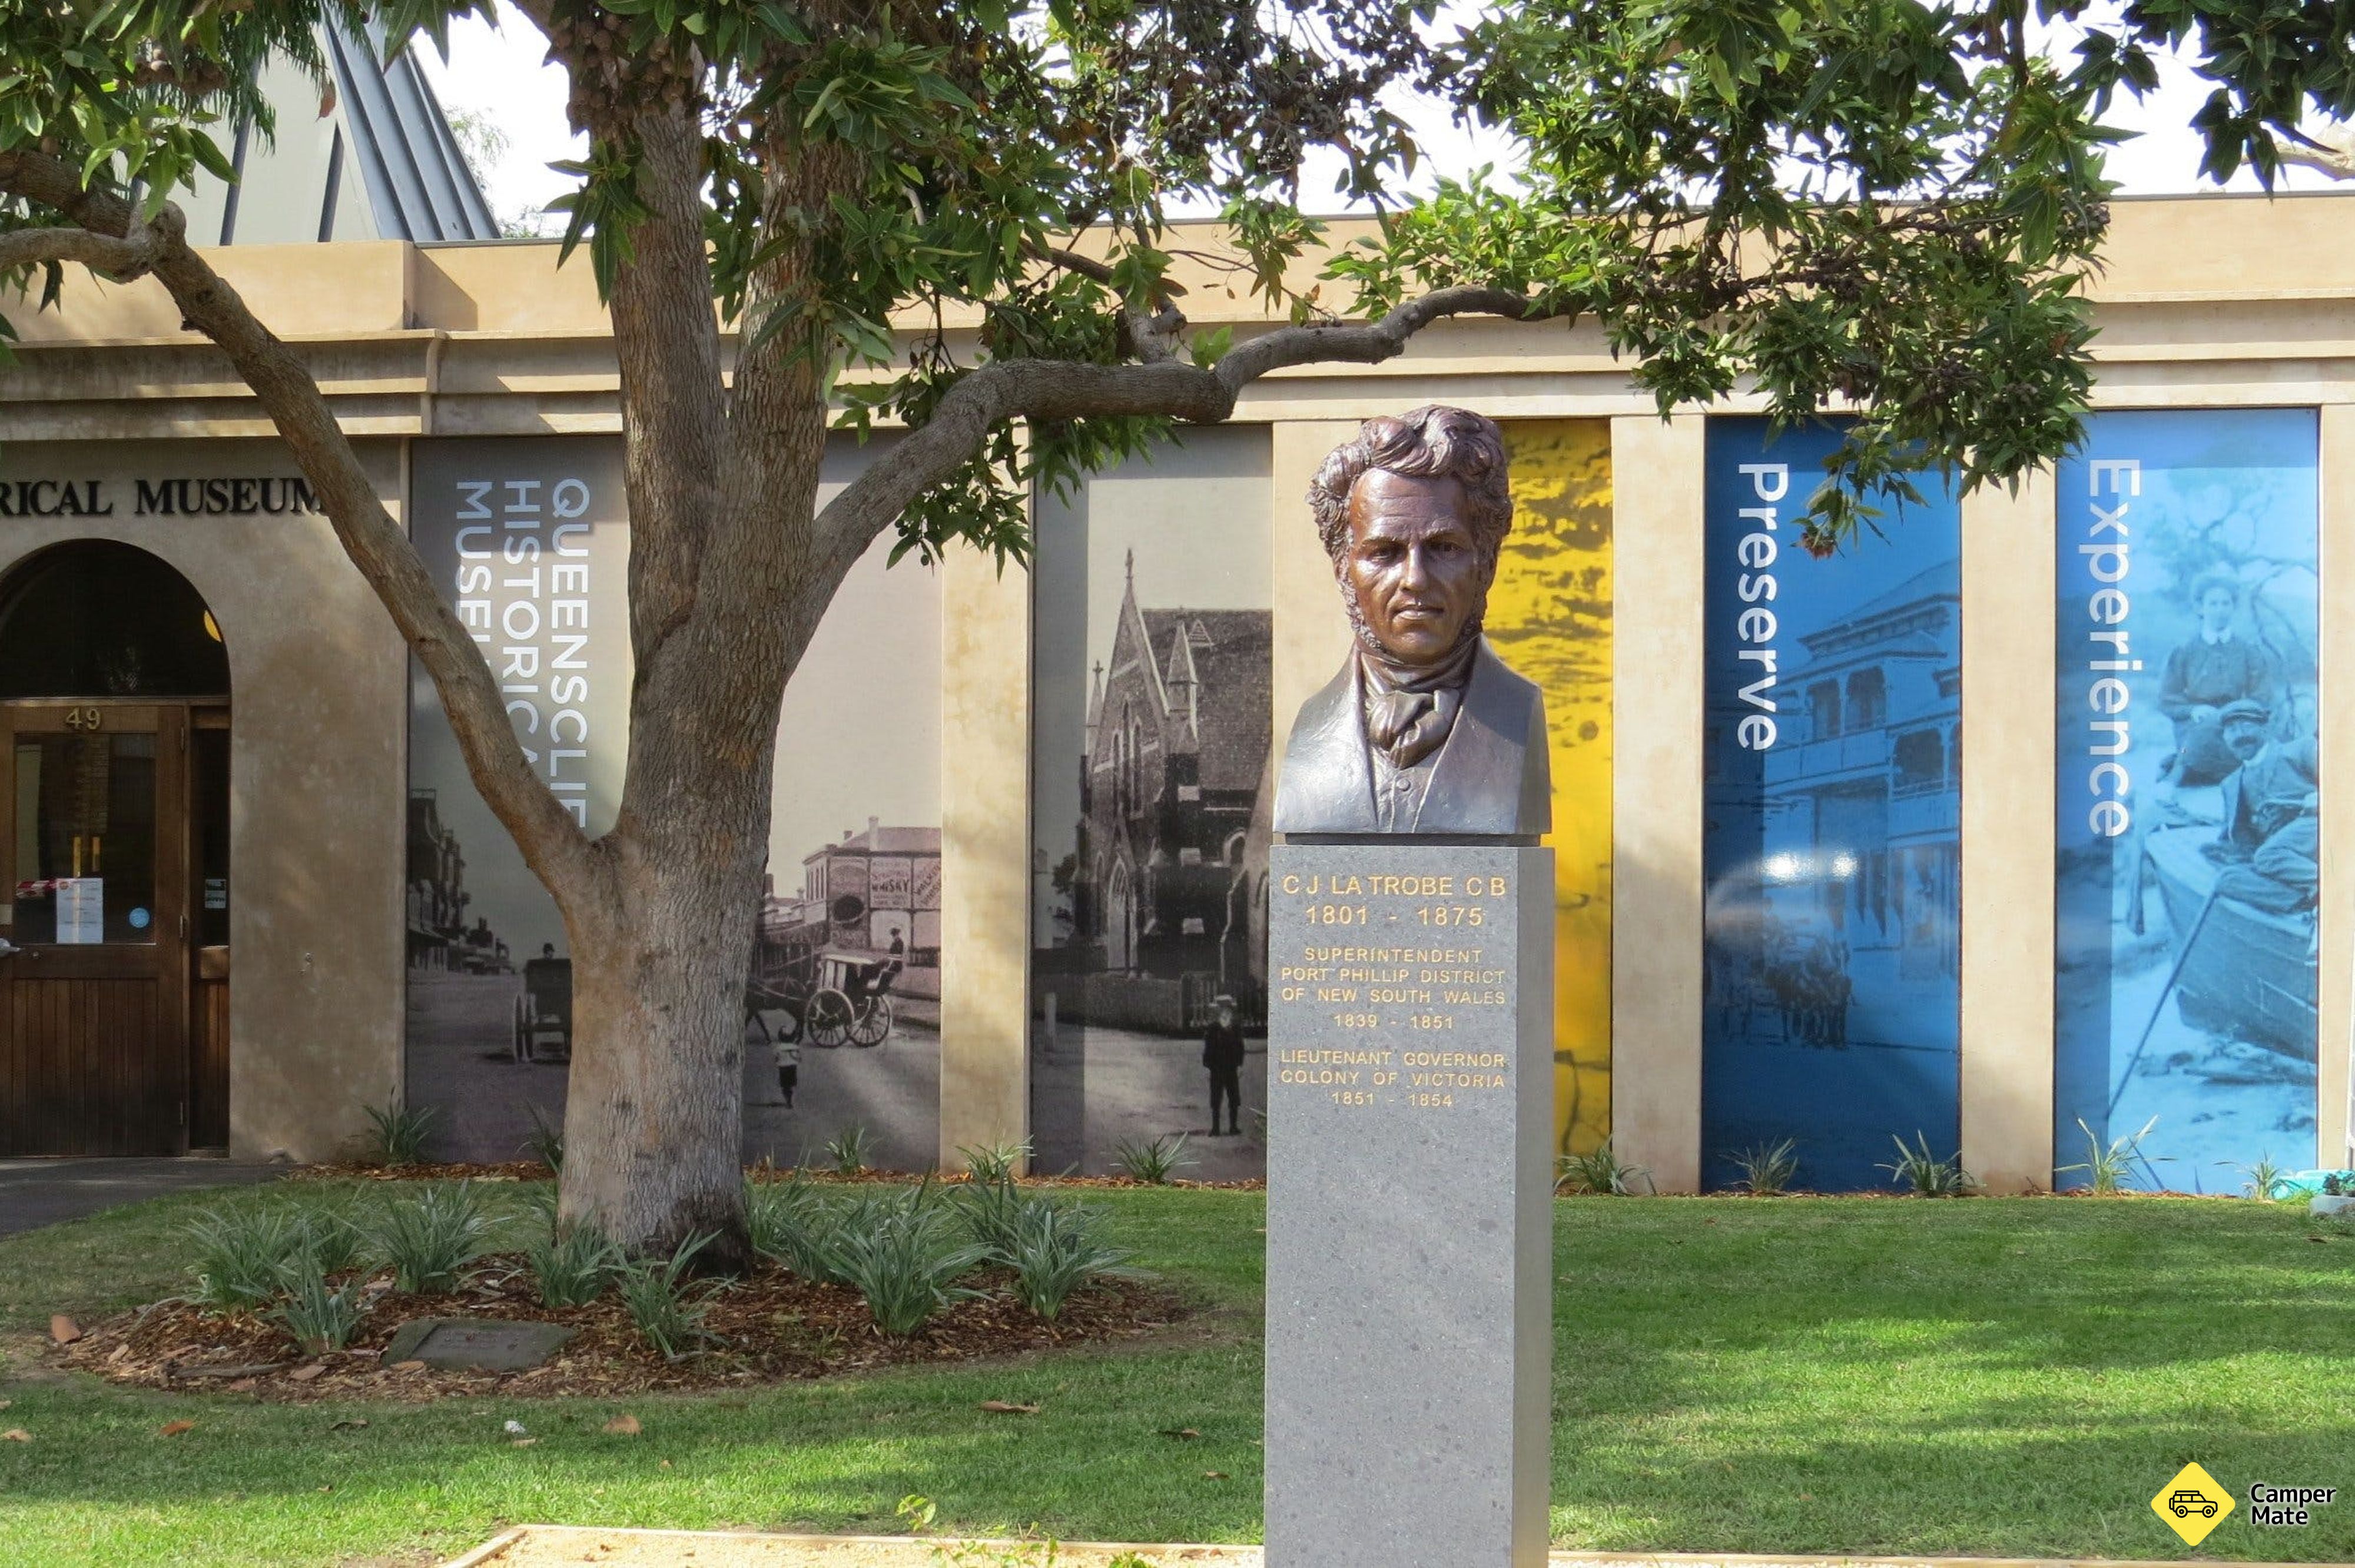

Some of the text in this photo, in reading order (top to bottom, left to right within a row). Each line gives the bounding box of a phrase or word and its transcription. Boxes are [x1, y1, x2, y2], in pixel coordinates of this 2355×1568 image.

[1737, 462, 1789, 751] Preserve
[2078, 459, 2144, 838] Experience
[65, 708, 101, 730] 49
[1331, 876, 1362, 895] LA
[1368, 876, 1453, 895] TROBE
[1306, 905, 1368, 925] 1801
[1418, 906, 1482, 926] 1875
[1305, 948, 1482, 963] SUPERINTENDENT
[1282, 968, 1505, 984] PORT PHILLIP DISTRICT
[1282, 988, 1505, 1004] OF NEW SOUTH WALES
[1334, 1014, 1377, 1028] 1839
[1411, 1015, 1454, 1029] 1851
[1281, 1050, 1505, 1067] LIEUTENANT GOVERNOR
[1281, 1070, 1505, 1088] COLONY OF VICTORIA
[1331, 1091, 1374, 1105] 1851
[1409, 1094, 1452, 1107] 1854
